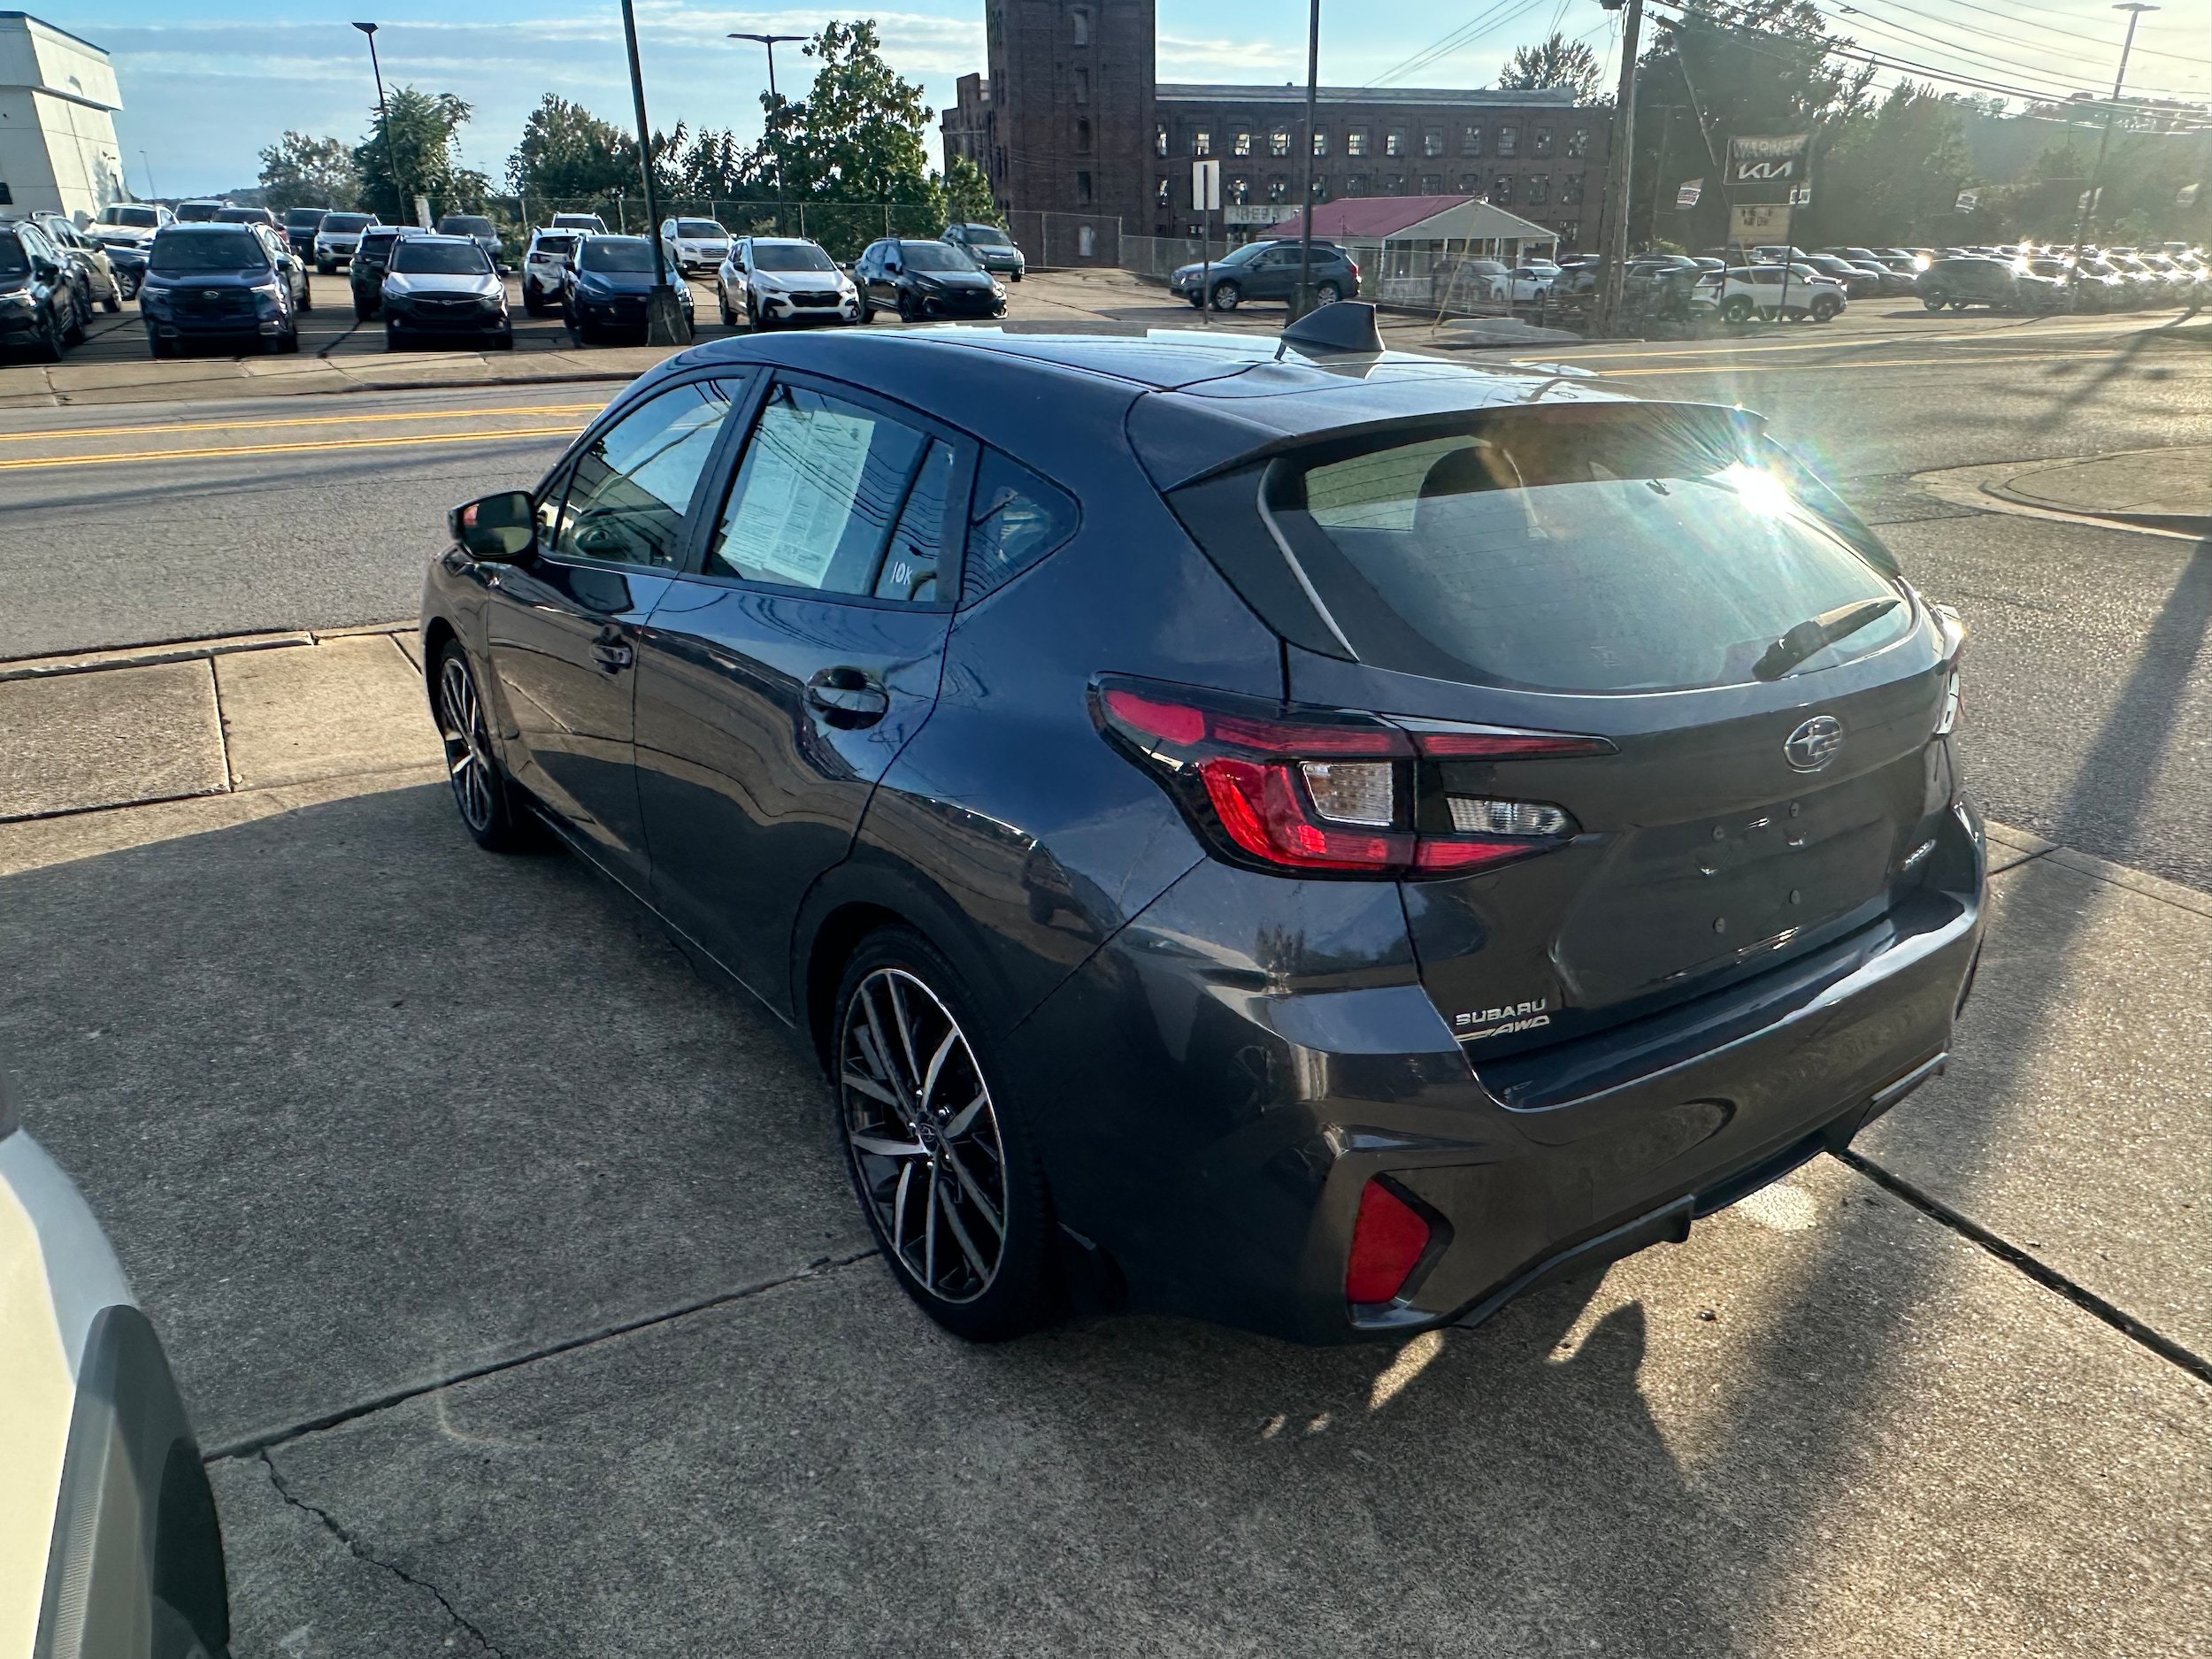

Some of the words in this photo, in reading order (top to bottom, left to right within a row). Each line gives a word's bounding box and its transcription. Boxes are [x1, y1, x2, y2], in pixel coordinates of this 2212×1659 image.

[1738, 160, 1793, 180] KIA
[1455, 998, 1546, 1025] SUBARU
[1490, 1014, 1550, 1037] AWD
